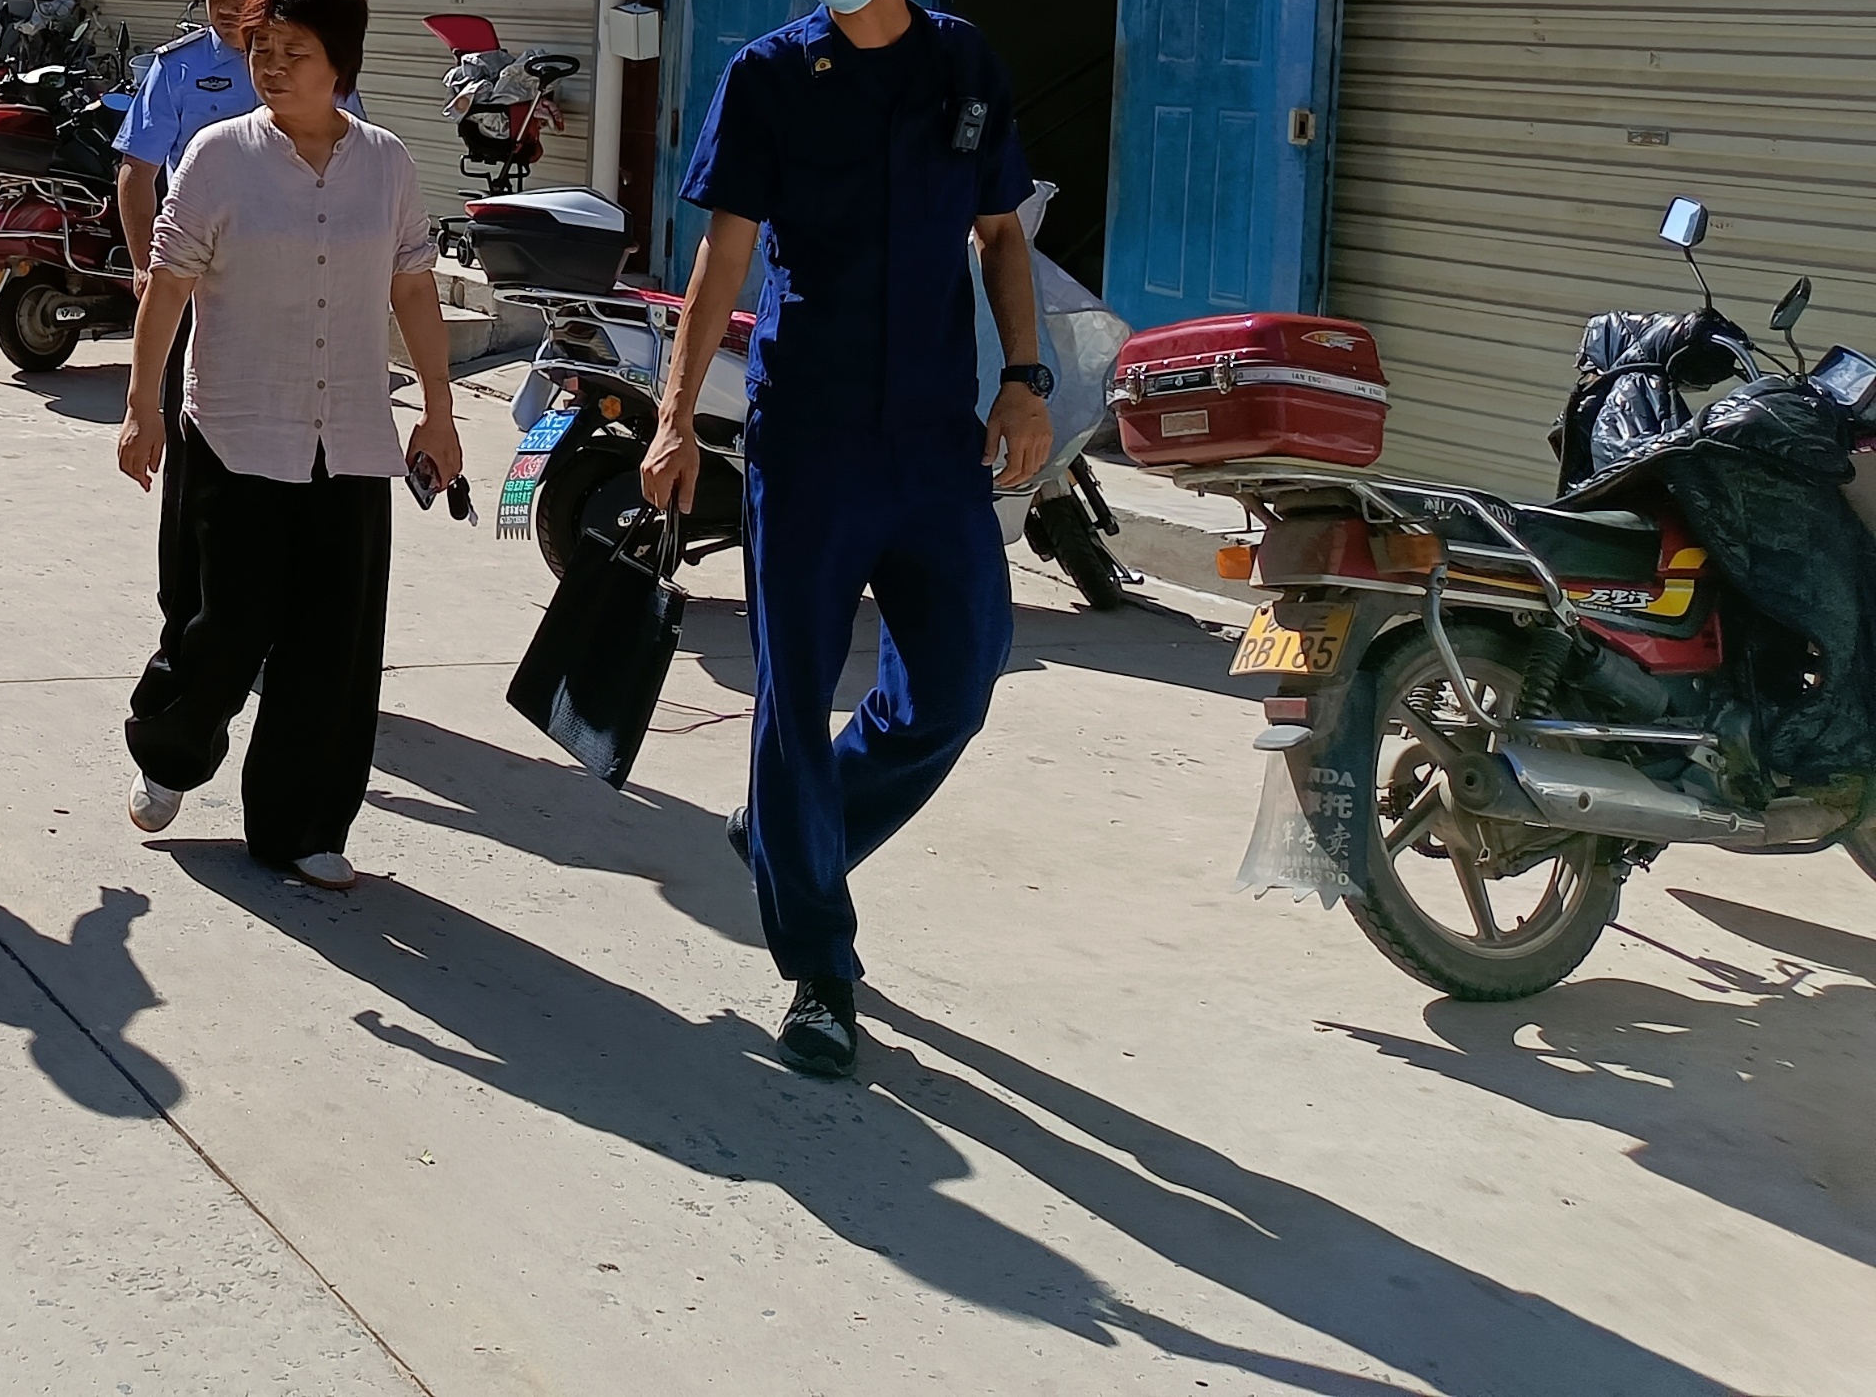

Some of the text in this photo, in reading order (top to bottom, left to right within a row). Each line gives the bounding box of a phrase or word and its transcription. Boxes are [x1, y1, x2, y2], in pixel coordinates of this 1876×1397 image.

[1578, 588, 1655, 608] 万里行
[1235, 636, 1338, 670] RB185
